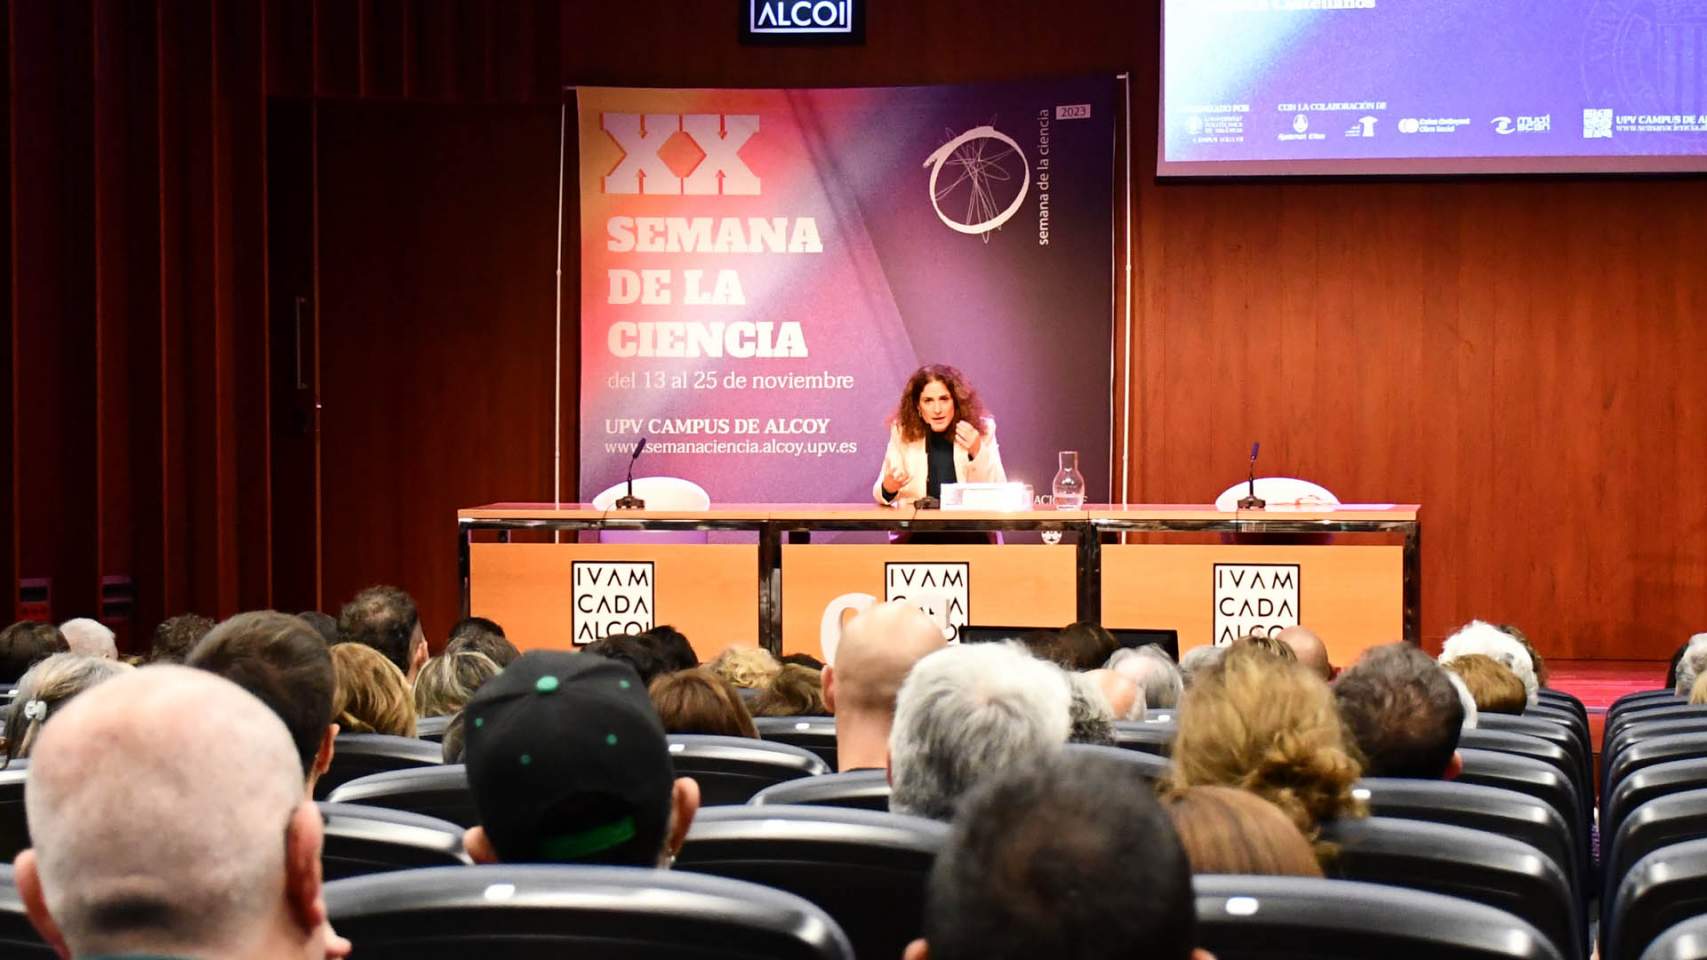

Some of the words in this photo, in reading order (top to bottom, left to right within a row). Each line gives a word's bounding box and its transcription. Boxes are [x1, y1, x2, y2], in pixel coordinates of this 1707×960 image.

[757, 1, 845, 26] ALCOI
[1060, 106, 1087, 117] 2023
[1036, 109, 1049, 155] ciencia
[602, 112, 761, 195] XX
[1036, 159, 1049, 170] la
[1036, 173, 1049, 190] de
[1039, 193, 1049, 246] semana
[606, 216, 823, 253] SEMANA
[607, 269, 672, 305] DE
[683, 269, 746, 305] LA
[607, 321, 808, 358] CIENCIA
[608, 372, 636, 389] del
[643, 372, 666, 389] 13
[671, 371, 687, 389] al
[694, 371, 717, 389] 25
[723, 371, 747, 389] de
[752, 371, 854, 389] noviembre
[605, 418, 643, 434] UPV
[648, 418, 730, 434] CAMPUS
[734, 418, 760, 434] DE
[764, 418, 831, 434] ALCOY
[577, 567, 649, 587] IVAM
[890, 568, 963, 587] IVAM
[1219, 569, 1294, 589] IVAM
[577, 593, 649, 614] CADA
[1219, 597, 1294, 617] CADA
